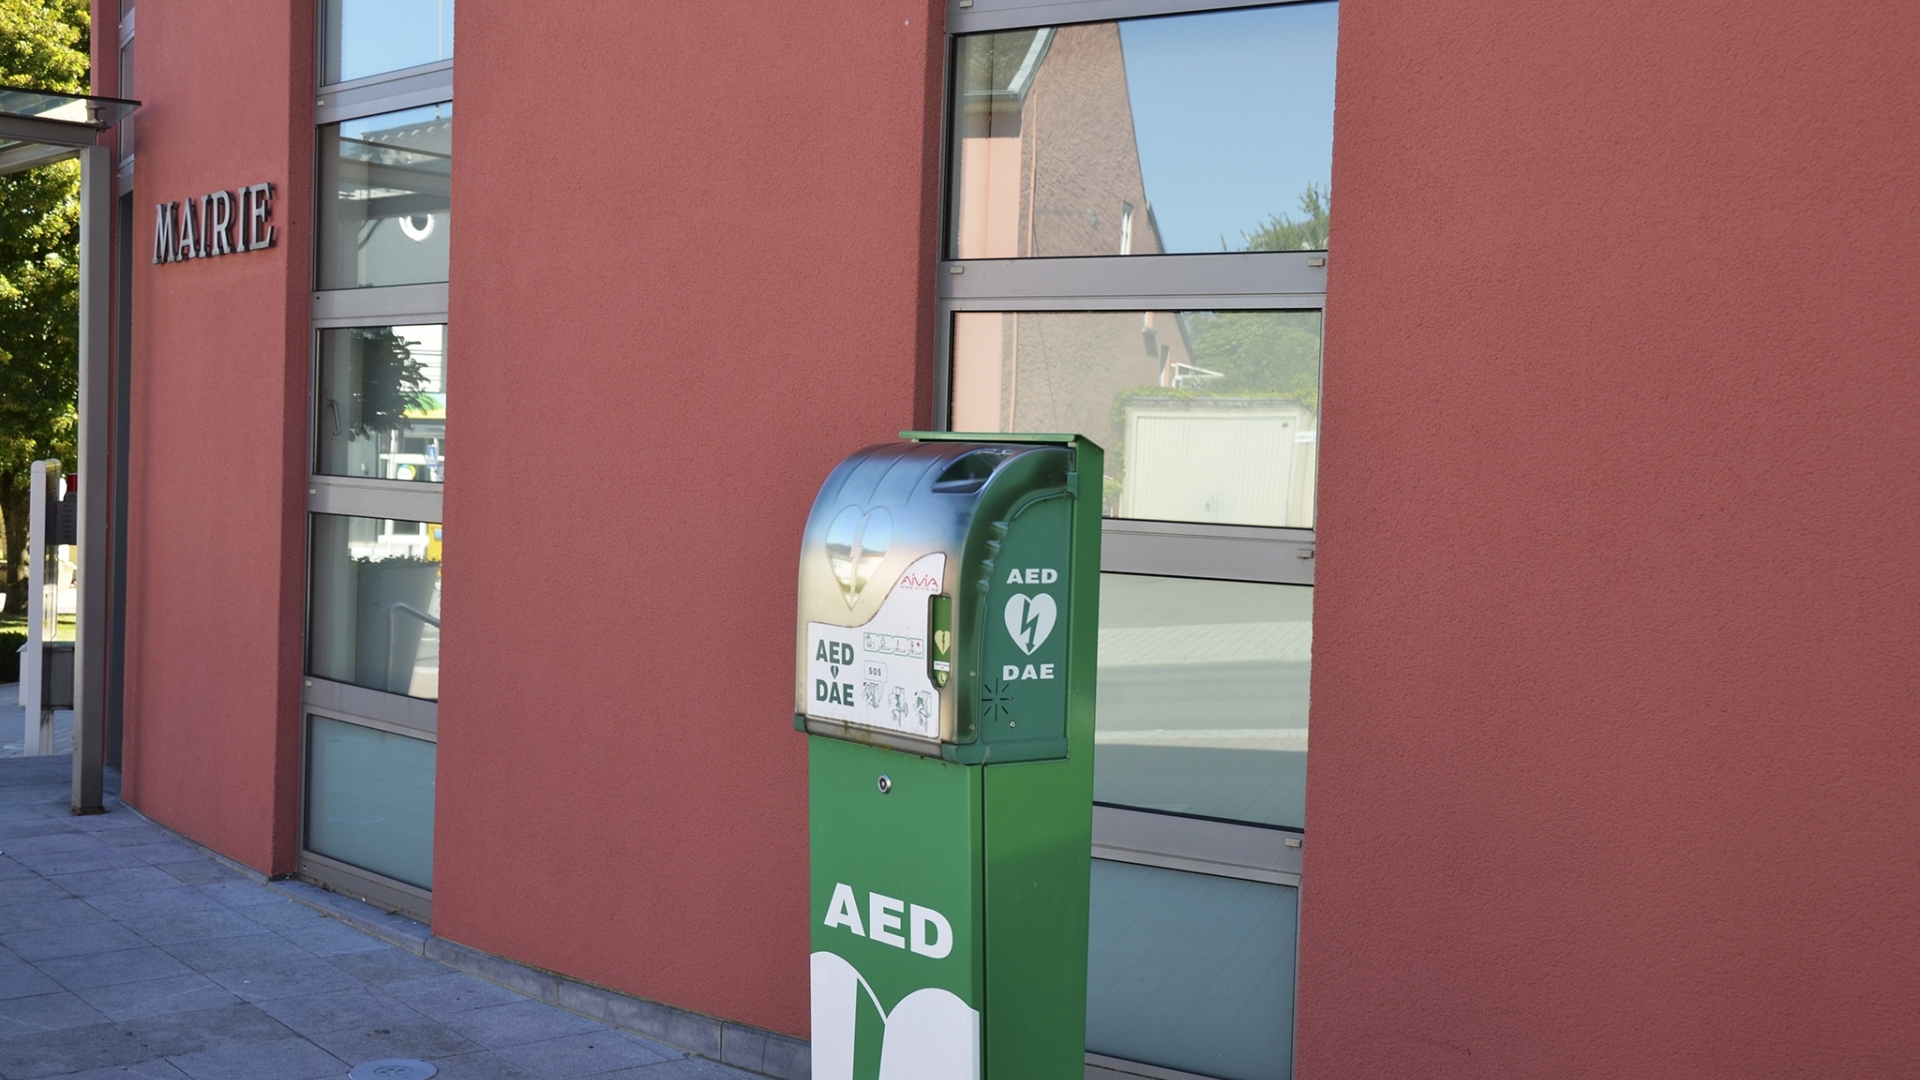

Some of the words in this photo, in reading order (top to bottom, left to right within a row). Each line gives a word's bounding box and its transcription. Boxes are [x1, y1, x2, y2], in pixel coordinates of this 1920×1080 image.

[152, 182, 275, 264] MAIRIE
[1006, 568, 1058, 584] AED
[815, 639, 854, 666] AED
[868, 667, 882, 676] SOS
[1002, 663, 1055, 681] DAE
[815, 678, 855, 707] DAE
[823, 882, 954, 960] AED
